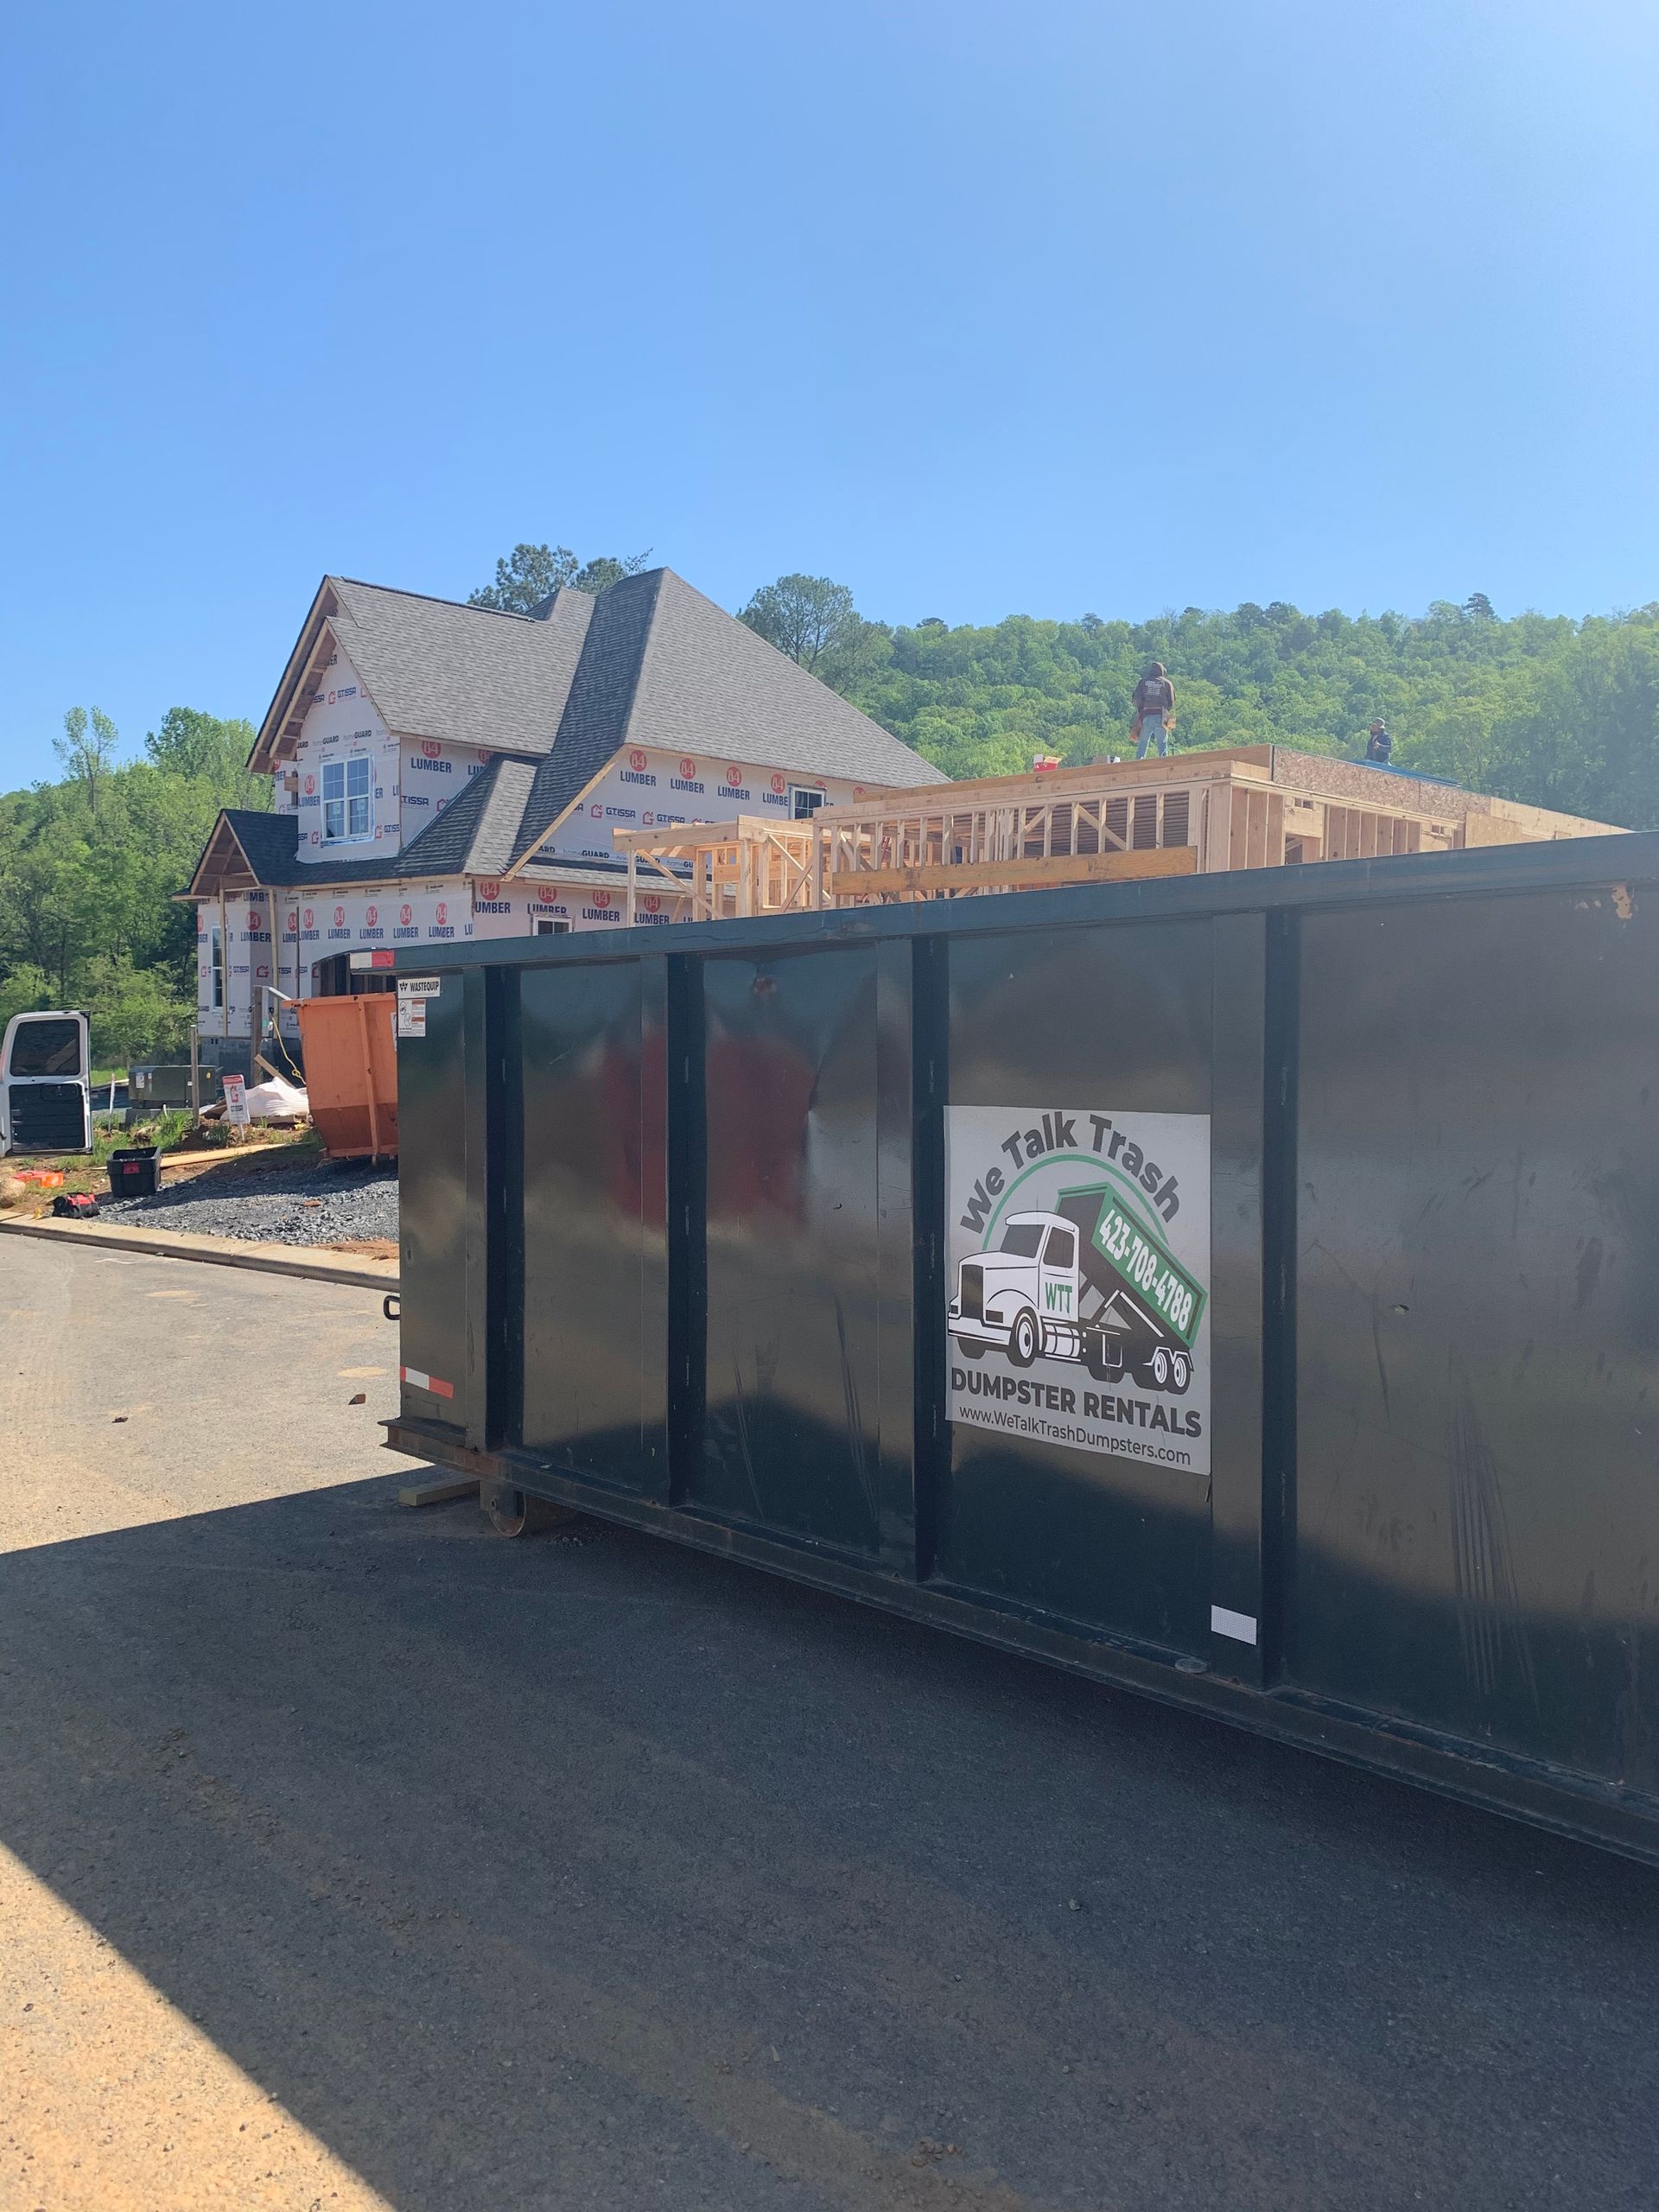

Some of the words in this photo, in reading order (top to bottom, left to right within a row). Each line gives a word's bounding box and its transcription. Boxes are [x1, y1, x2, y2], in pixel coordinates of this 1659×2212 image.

[410, 758, 452, 773] LUMBER
[620, 771, 657, 786] LUMBER
[671, 778, 705, 794] LUMBER
[717, 785, 750, 800] LUMBER
[298, 796, 321, 807] LUMBER
[762, 792, 788, 806] LUMBE
[475, 900, 512, 914] UMBER
[582, 908, 620, 923] LUMBER
[634, 912, 670, 925] LUMBER
[240, 931, 272, 943] LUMBER
[328, 928, 351, 939] LUMBER
[359, 928, 384, 939] LUMBER
[393, 926, 419, 939] LUMBER
[429, 925, 454, 938] LUMBER
[410, 981, 440, 993] WASTEQUIP
[960, 1164, 1006, 1236] We
[1001, 1110, 1078, 1171] Talk
[1088, 1113, 1184, 1224] Trash
[1098, 1209, 1194, 1333] 423-708-4788
[1045, 1281, 1073, 1314] WTT
[951, 1366, 1077, 1415] DUMPSTER
[1084, 1392, 1203, 1439] RENTALS
[959, 1406, 1192, 1466] www.WeTalkTrashDumpsters.com
